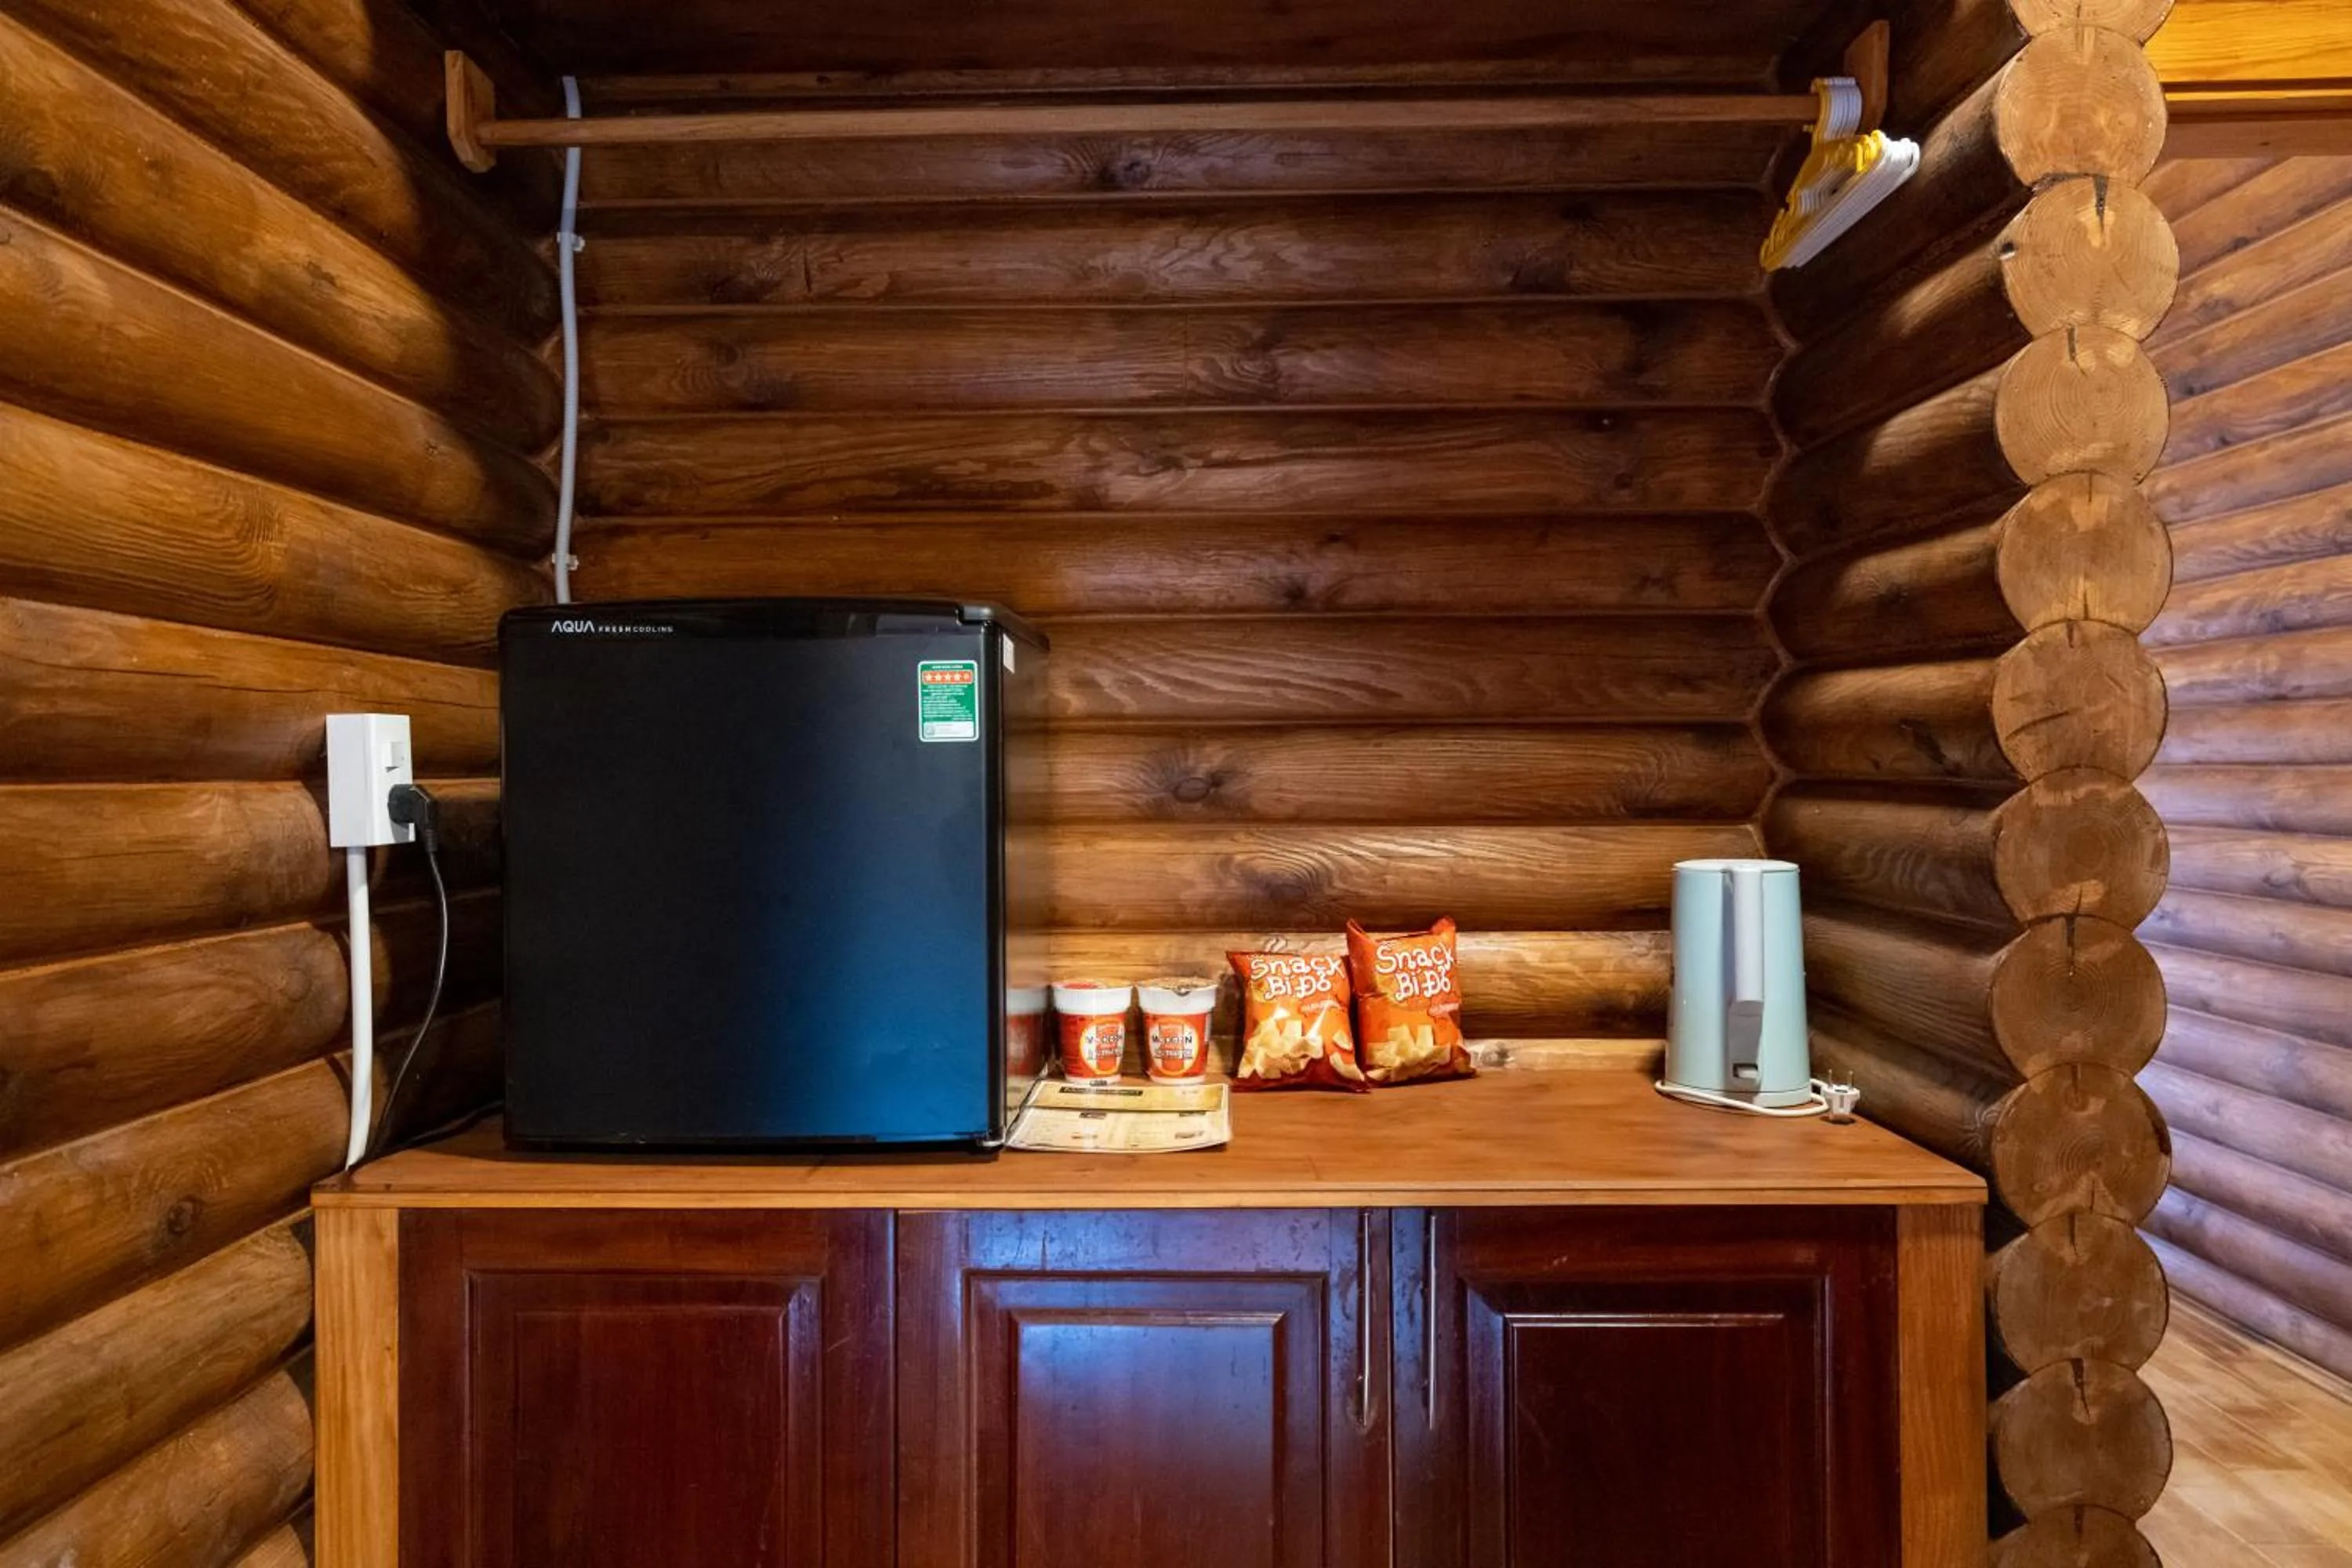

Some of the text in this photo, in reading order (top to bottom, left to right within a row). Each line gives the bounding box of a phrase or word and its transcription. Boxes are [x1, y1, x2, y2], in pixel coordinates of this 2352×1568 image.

[551, 620, 595, 633] AQUA
[1250, 955, 1345, 979] Snack
[1376, 942, 1454, 973] Snack
